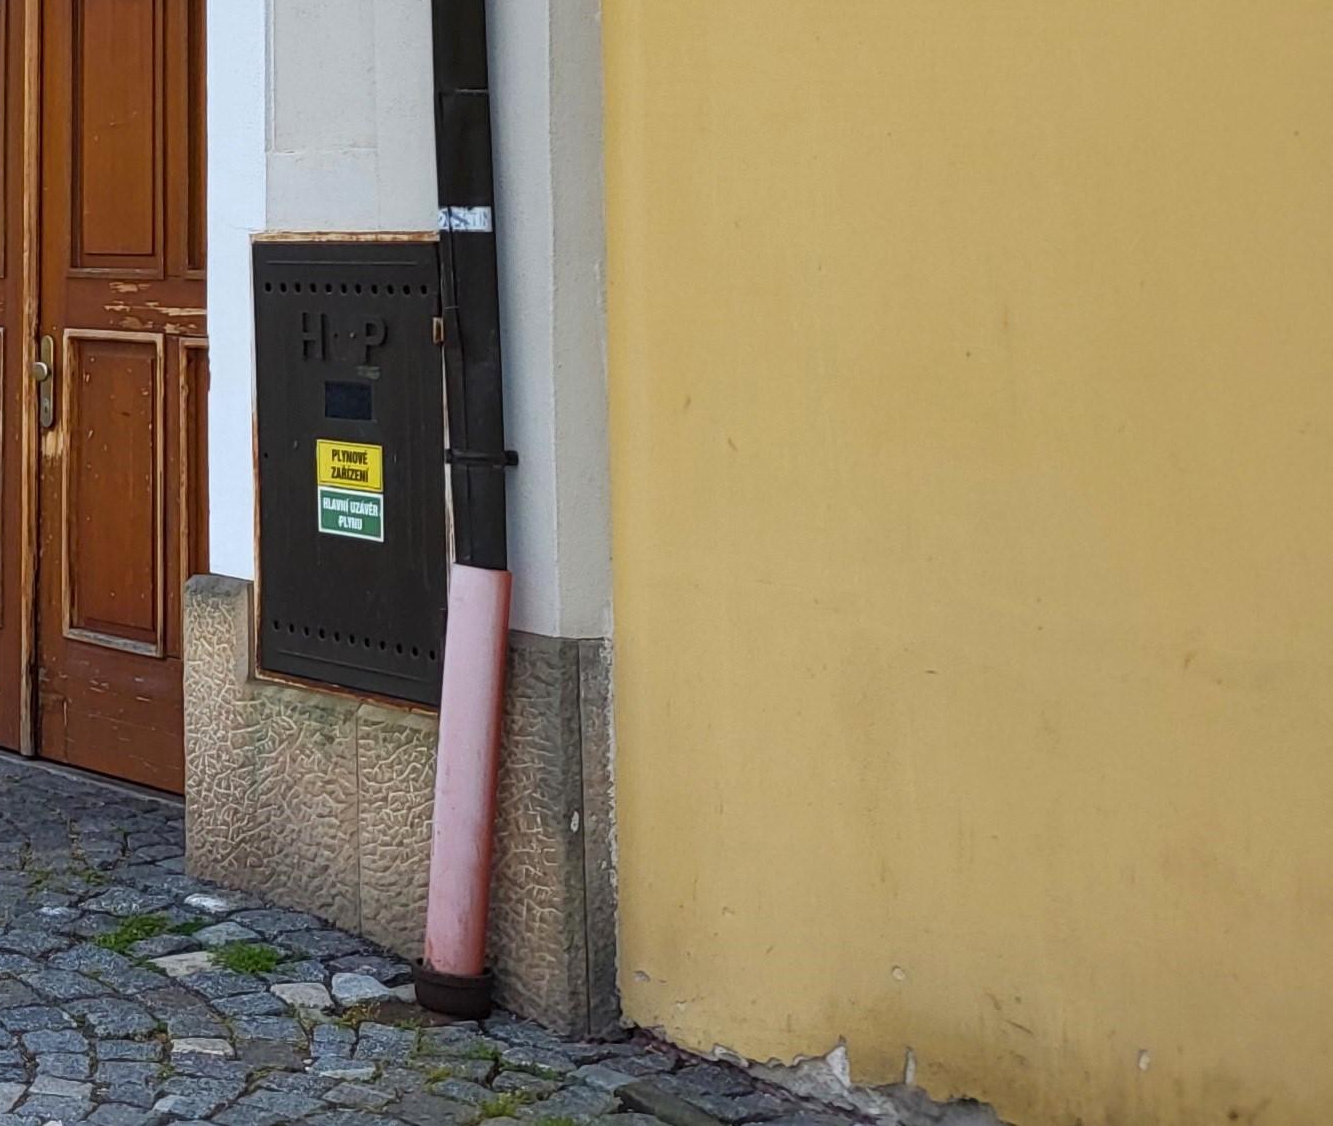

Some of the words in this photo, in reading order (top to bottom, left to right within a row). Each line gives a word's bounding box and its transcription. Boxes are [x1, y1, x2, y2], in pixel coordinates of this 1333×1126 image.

[331, 449, 368, 465] PLYNOVÉ
[331, 465, 369, 483] ZAŘÍZENÍ
[323, 496, 349, 513] HLAVNÍ
[338, 515, 363, 530] PLYNU
